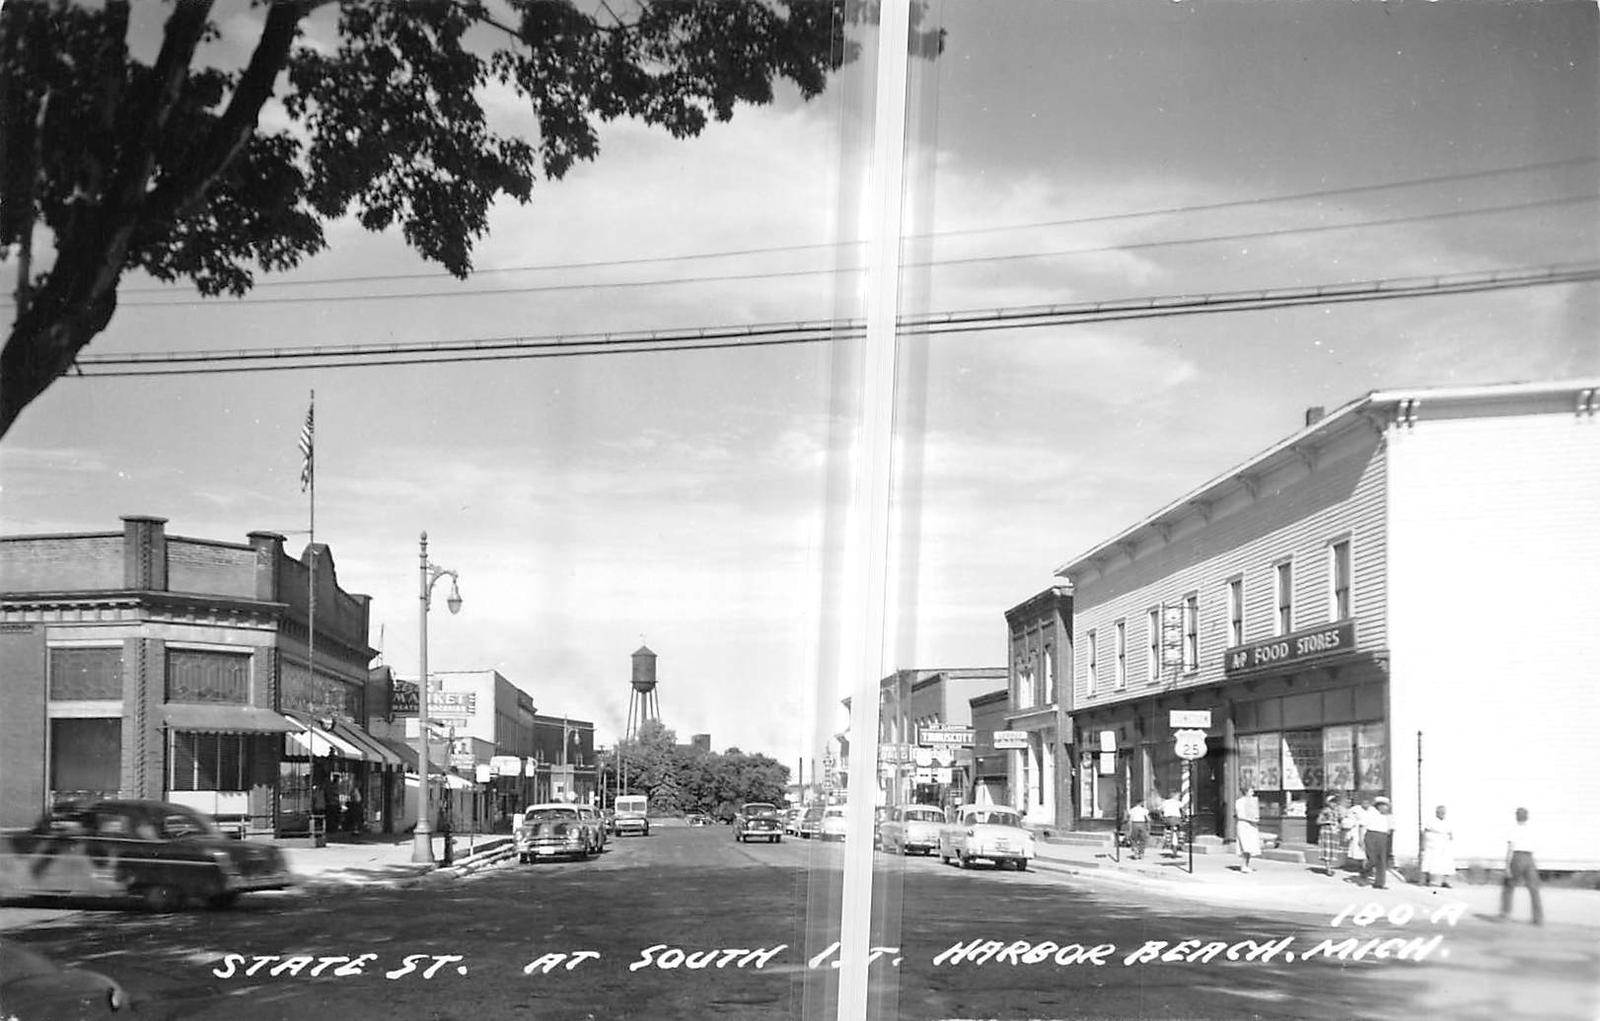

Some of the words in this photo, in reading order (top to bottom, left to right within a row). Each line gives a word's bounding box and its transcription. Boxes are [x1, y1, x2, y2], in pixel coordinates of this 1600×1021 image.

[1254, 642, 1289, 664] FOOD
[1296, 630, 1341, 655] STORES
[392, 692, 466, 704] MAKET
[1183, 743, 1200, 756] 25
